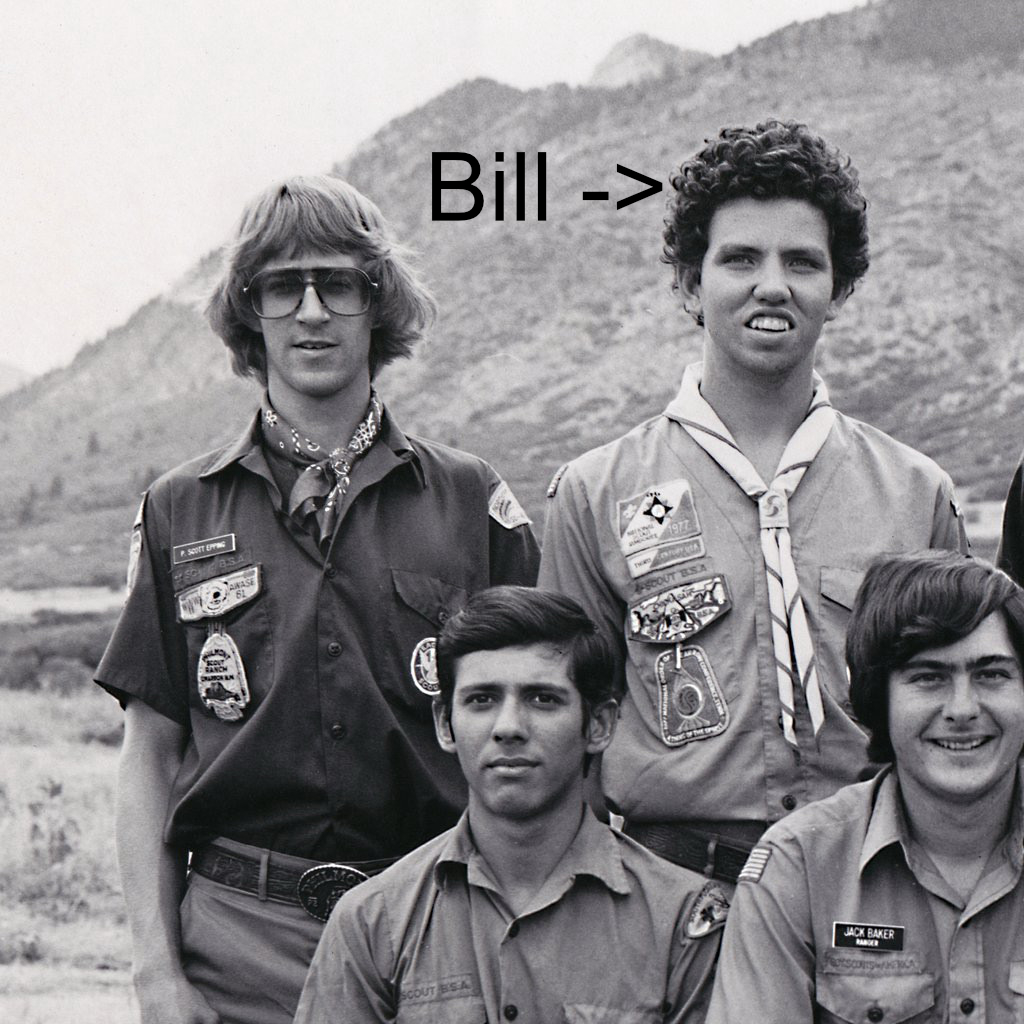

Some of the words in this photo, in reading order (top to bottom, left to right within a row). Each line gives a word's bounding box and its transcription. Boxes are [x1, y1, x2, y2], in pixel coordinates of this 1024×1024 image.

[668, 520, 690, 534] 1977
[844, 926, 865, 937] JACK
[867, 928, 895, 939] BAKER
[855, 938, 879, 947] RANGER
[401, 985, 435, 1001] SCOUT
